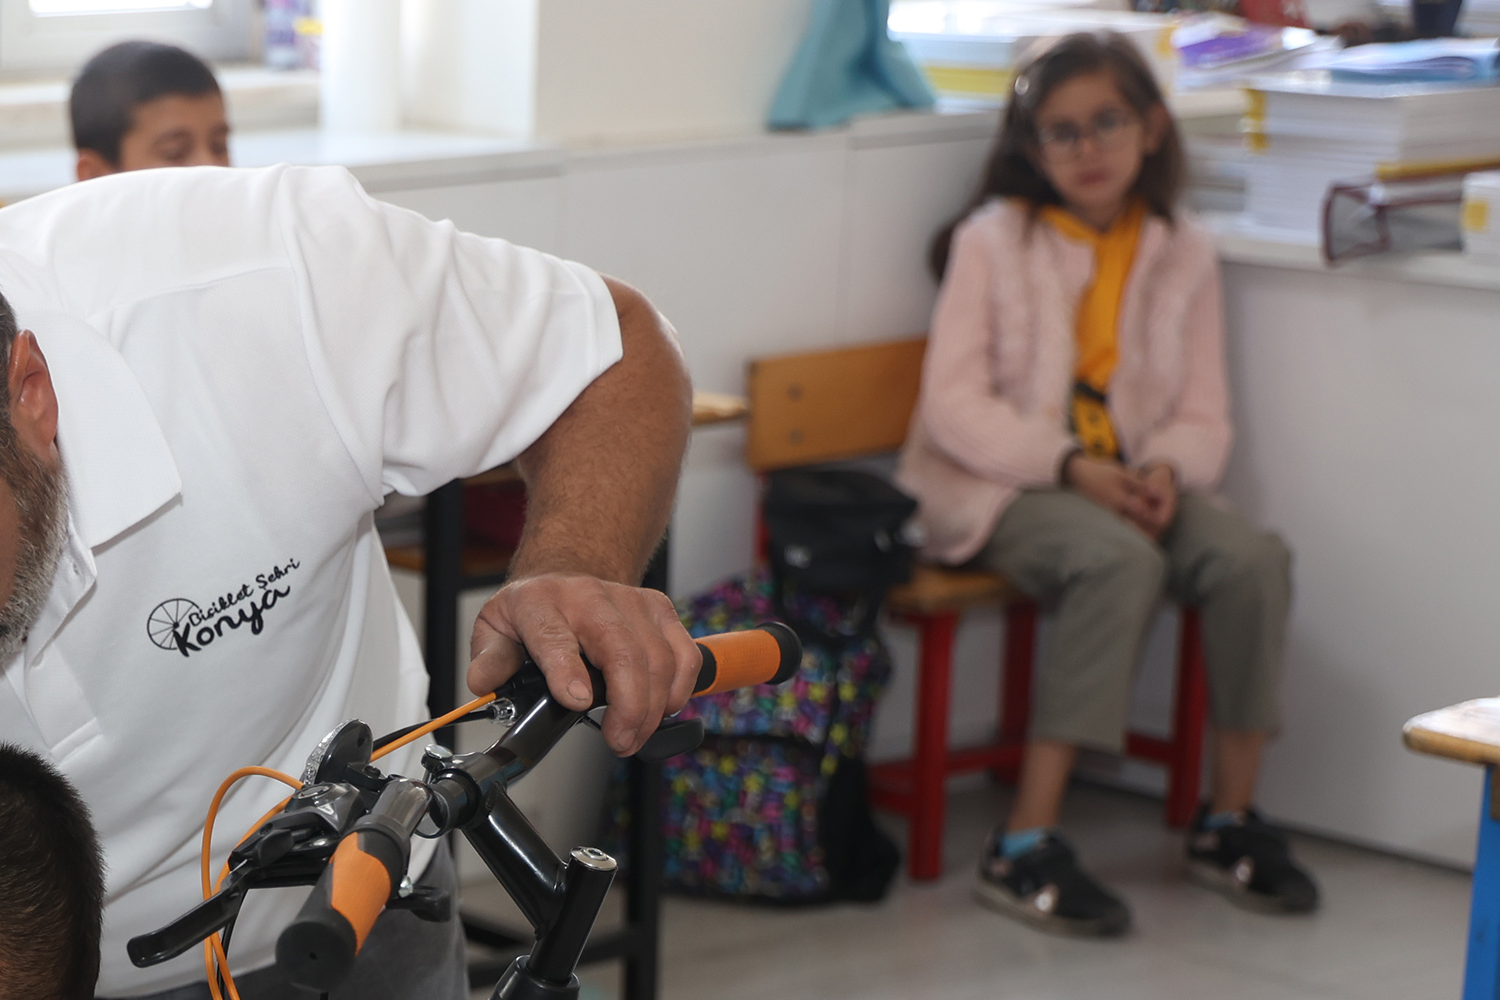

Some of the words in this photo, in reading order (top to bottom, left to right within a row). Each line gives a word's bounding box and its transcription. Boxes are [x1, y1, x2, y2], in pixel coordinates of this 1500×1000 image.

[172, 585, 291, 657] Konya
[188, 583, 254, 627] Bisiklet
[255, 558, 300, 590] Şehri
